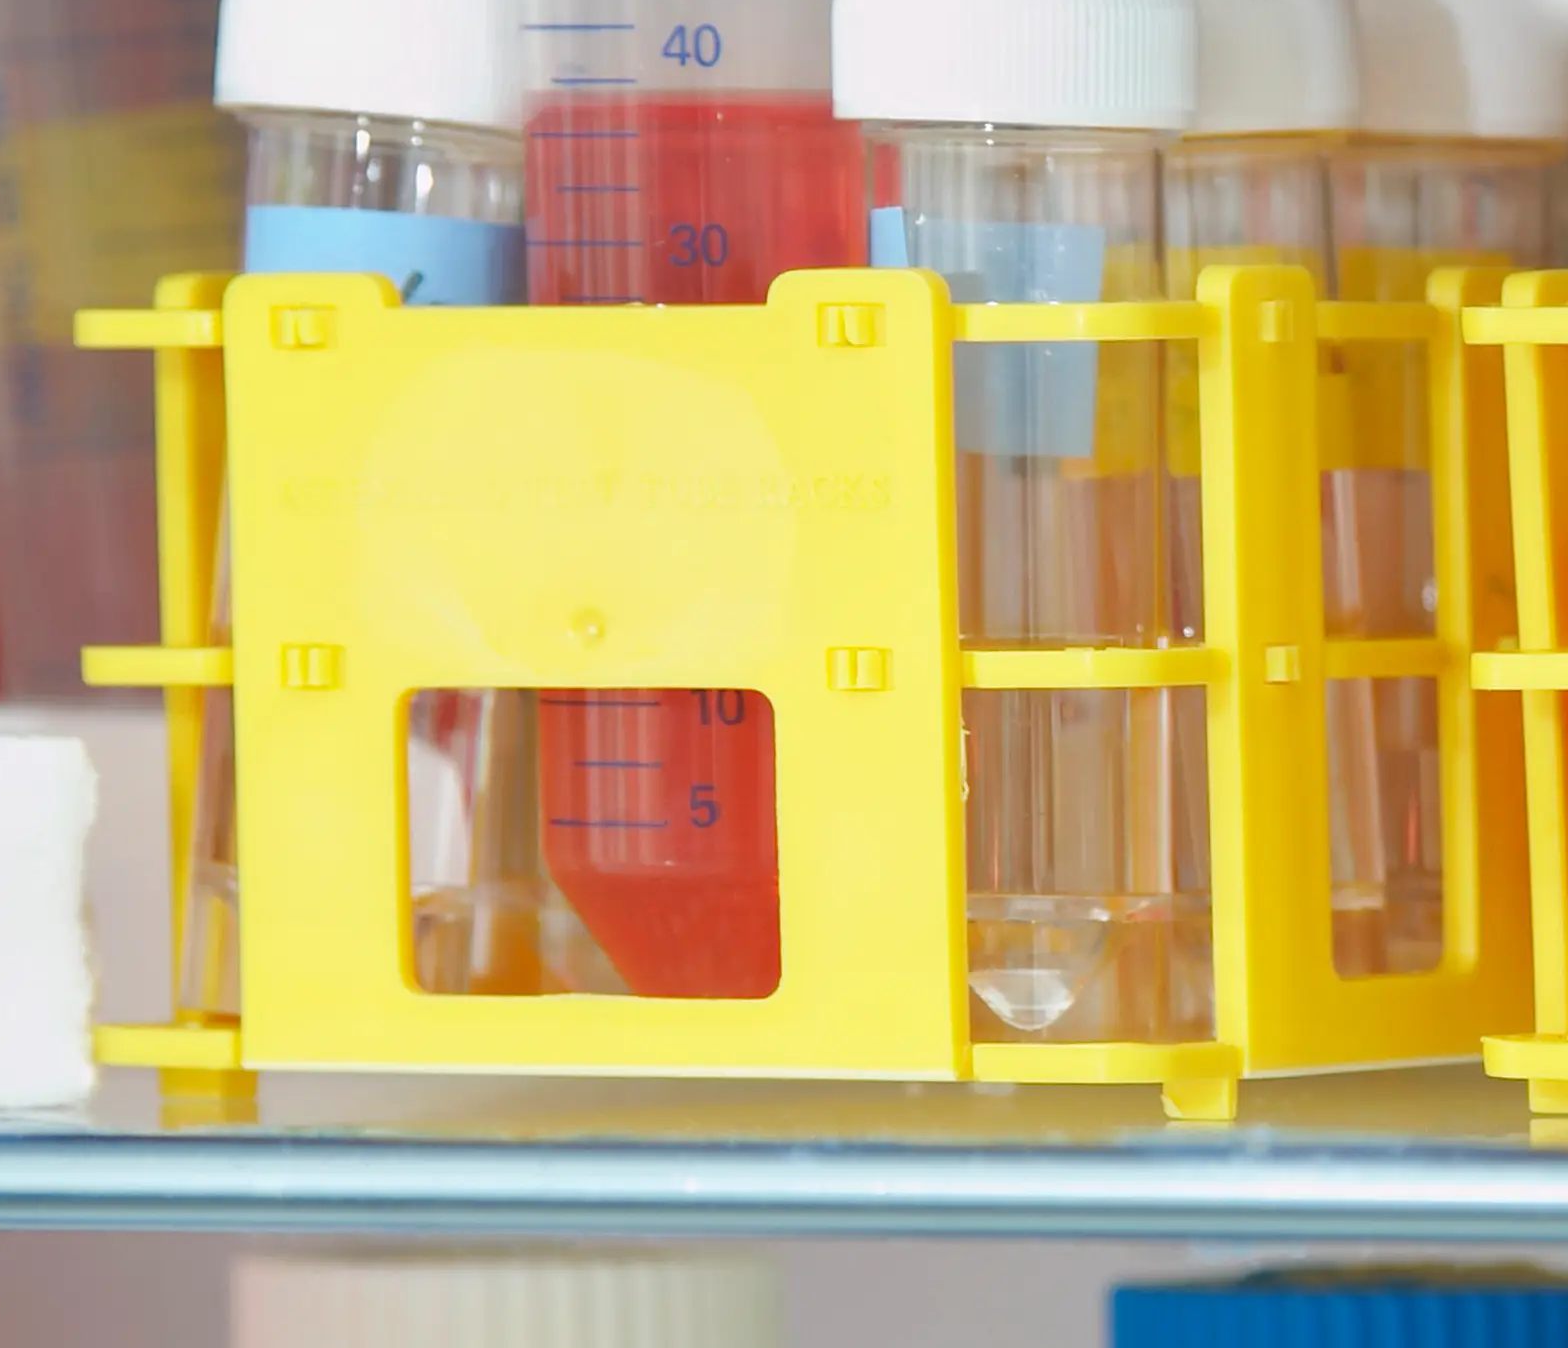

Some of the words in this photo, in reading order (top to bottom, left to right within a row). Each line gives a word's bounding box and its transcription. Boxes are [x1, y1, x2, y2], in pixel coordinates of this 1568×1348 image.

[661, 23, 723, 68] 40
[668, 223, 729, 268] 30
[692, 689, 745, 726] 10
[688, 783, 721, 829] 5
